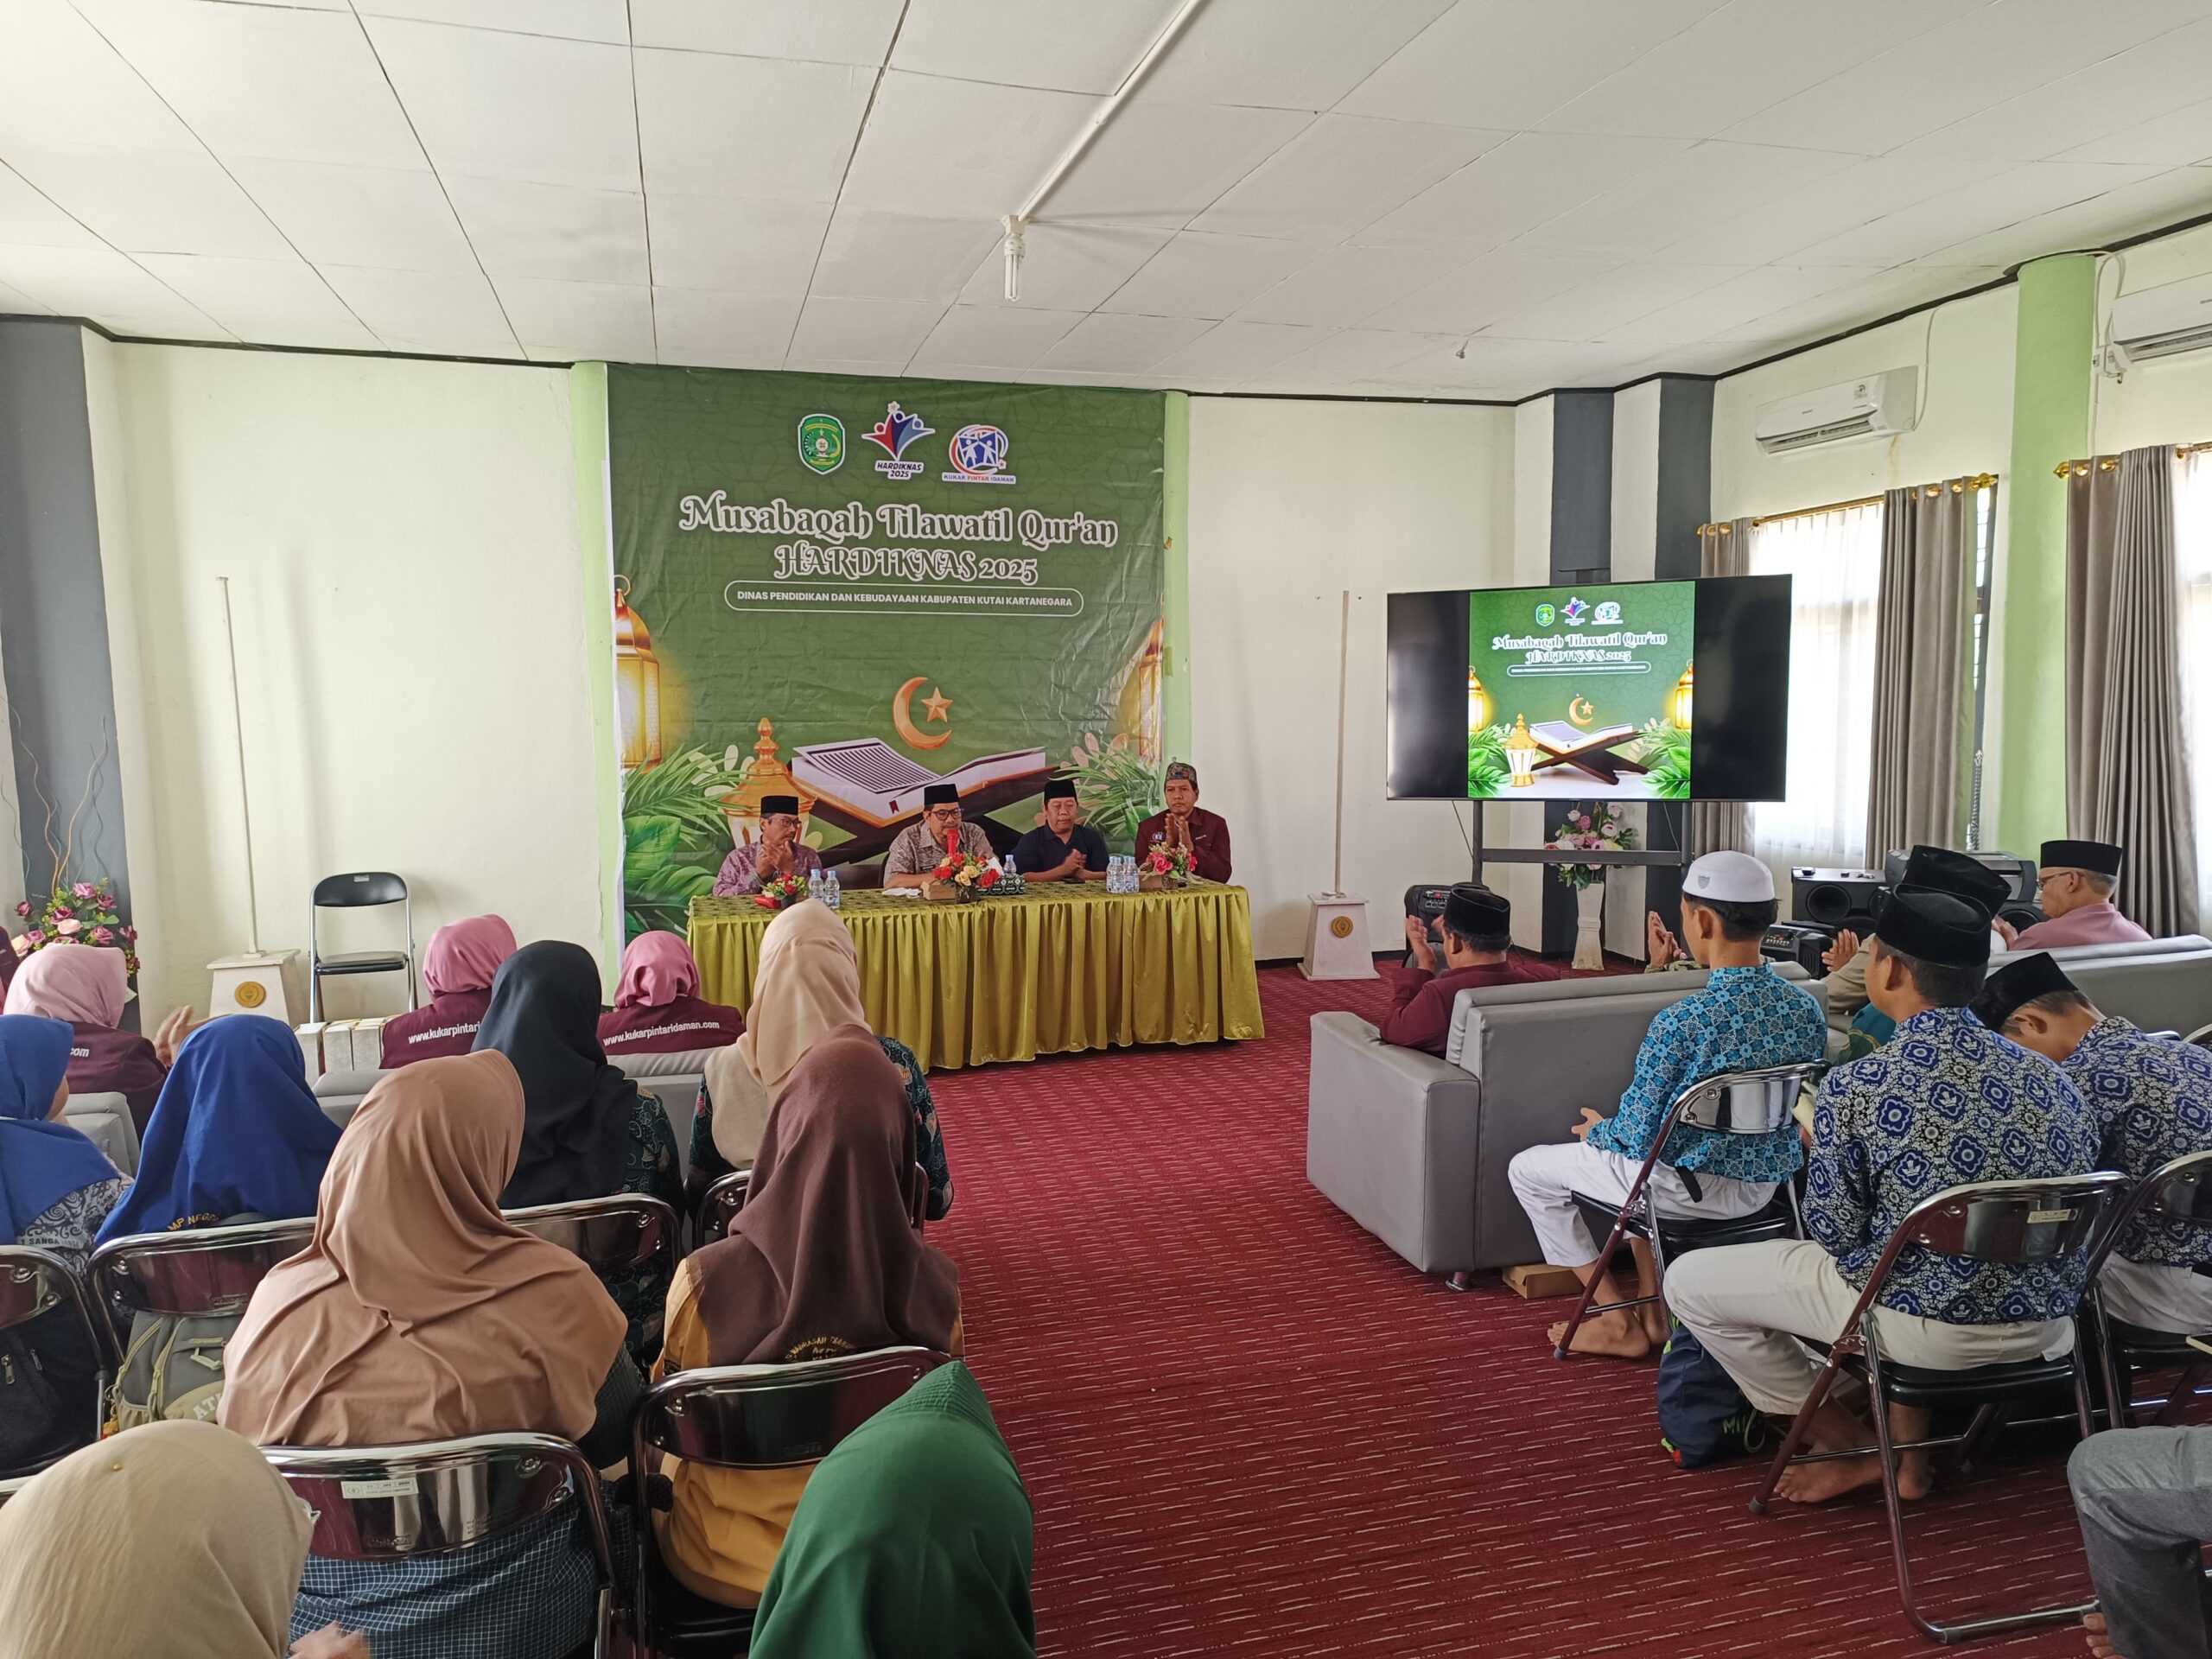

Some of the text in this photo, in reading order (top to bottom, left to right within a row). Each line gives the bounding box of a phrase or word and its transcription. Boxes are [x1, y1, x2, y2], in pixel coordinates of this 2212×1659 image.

[876, 461, 922, 471] HARDIKNAS
[678, 489, 1119, 551] Musabaqah Tilawatil Qur'an
[773, 539, 1039, 586] HARDIKNAS 2025
[737, 590, 1073, 607] DINAS PENDIDIKAN DAN KEBUDAYAAN KABUPATEN KUTAI KARTANEGARA
[1605, 651, 1632, 662] 2025
[603, 1021, 721, 1046] www.kukarpintaridaman.com
